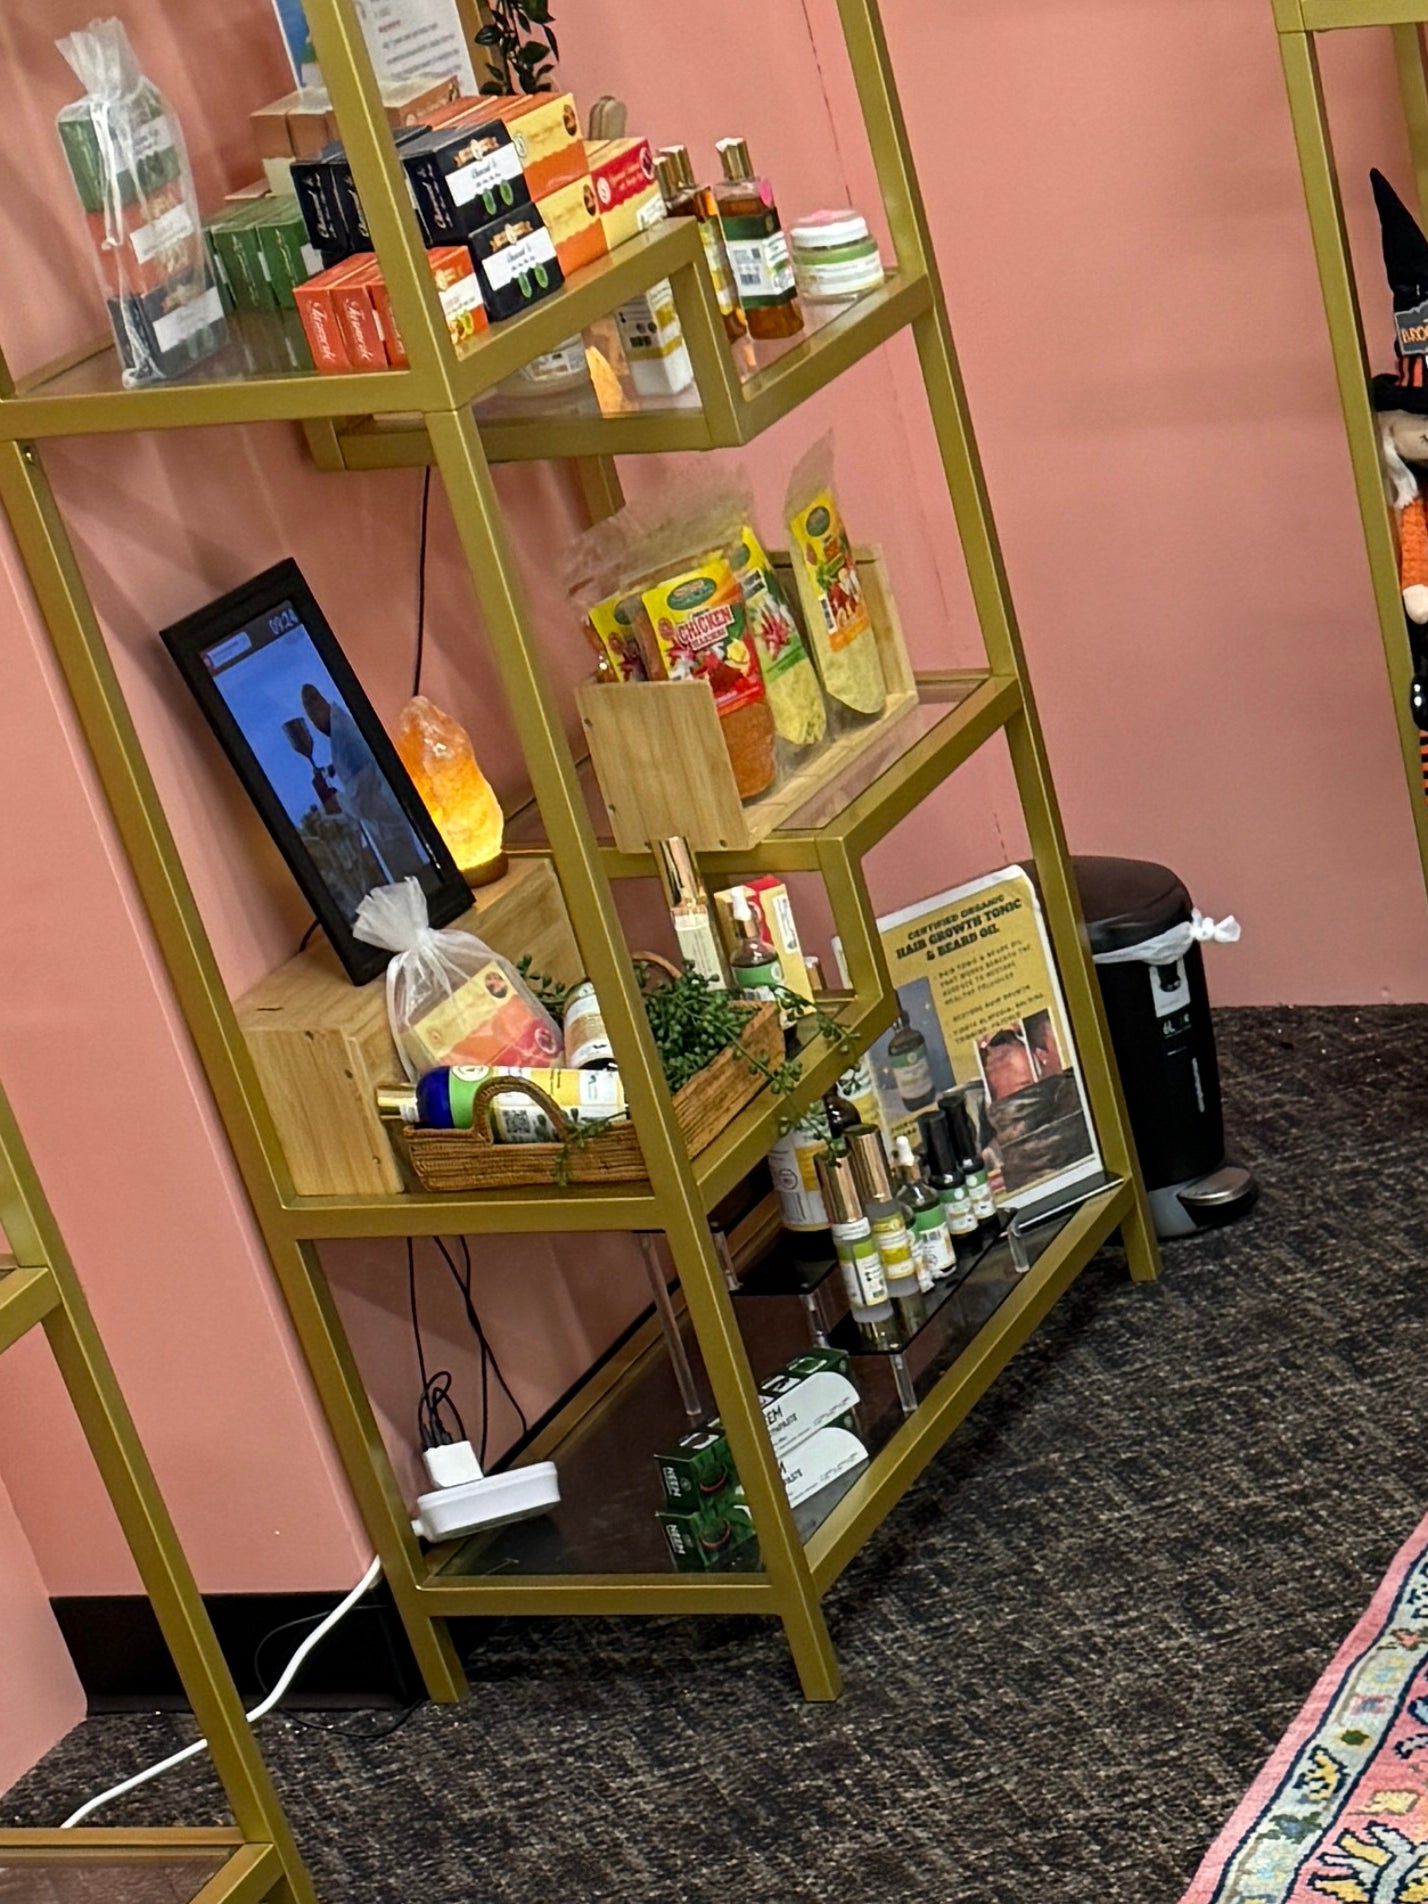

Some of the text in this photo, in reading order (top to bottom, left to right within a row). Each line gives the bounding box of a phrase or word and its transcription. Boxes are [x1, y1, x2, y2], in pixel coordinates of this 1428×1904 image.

[677, 605, 732, 643] CHICKEN
[895, 898, 1022, 959] HAIR GROWTH TONIC
[907, 894, 1005, 940] CERTIFIED ORGANIC
[926, 923, 1000, 961] & BEARD OIL
[767, 1404, 784, 1425] EM
